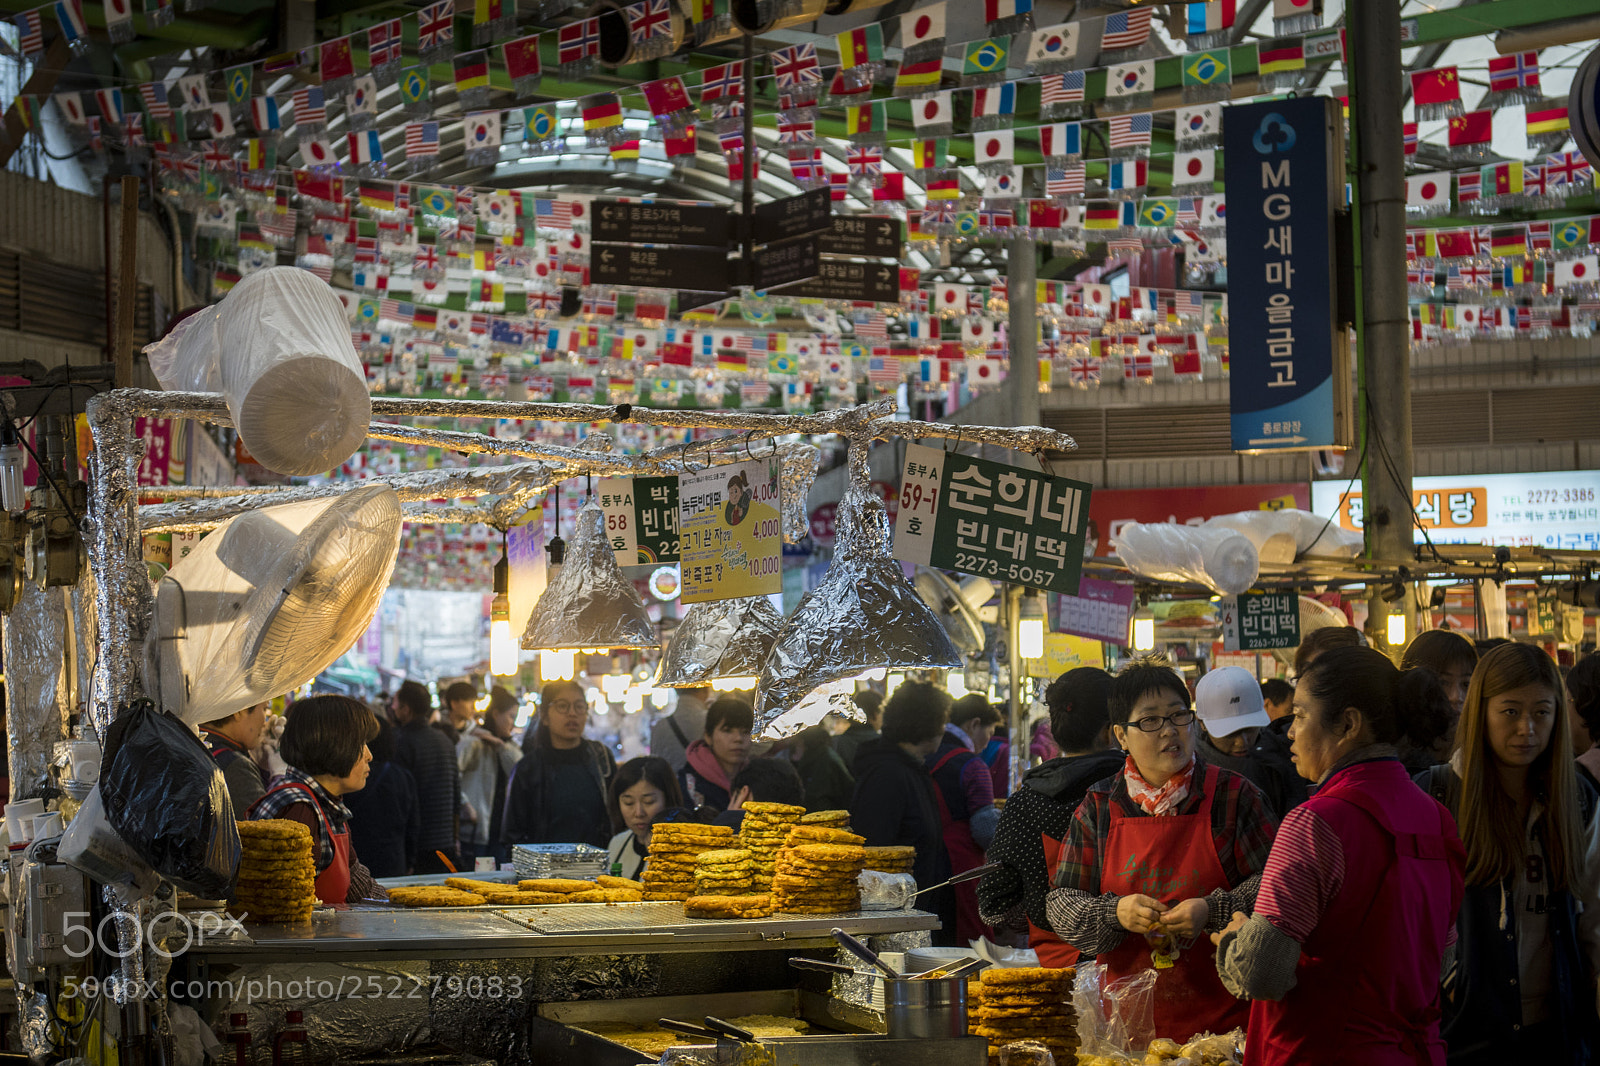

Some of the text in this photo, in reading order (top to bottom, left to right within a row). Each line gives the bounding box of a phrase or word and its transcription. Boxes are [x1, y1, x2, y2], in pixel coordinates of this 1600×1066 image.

[631, 207, 680, 222] 종로5가역
[630, 252, 658, 265] 북2문
[1261, 159, 1297, 388] MG새마을금고
[682, 482, 778, 515] 녹두빈대떡 4,000
[901, 482, 938, 515] 59-1
[949, 464, 1082, 535] 순희네
[1527, 486, 1595, 504] 2272-3385
[608, 514, 627, 531] 58
[906, 517, 922, 536] 호
[611, 536, 628, 551] 호
[683, 527, 722, 550] 고기완자
[753, 518, 779, 542] 4,000
[957, 518, 1067, 569] 빈대떡
[684, 556, 779, 586] 반죽포장 10,000
[954, 553, 1055, 587] 2273-5057
[1247, 596, 1290, 614] 순희네
[1225, 612, 1232, 624] 6
[1242, 614, 1296, 636] 빈대떡
